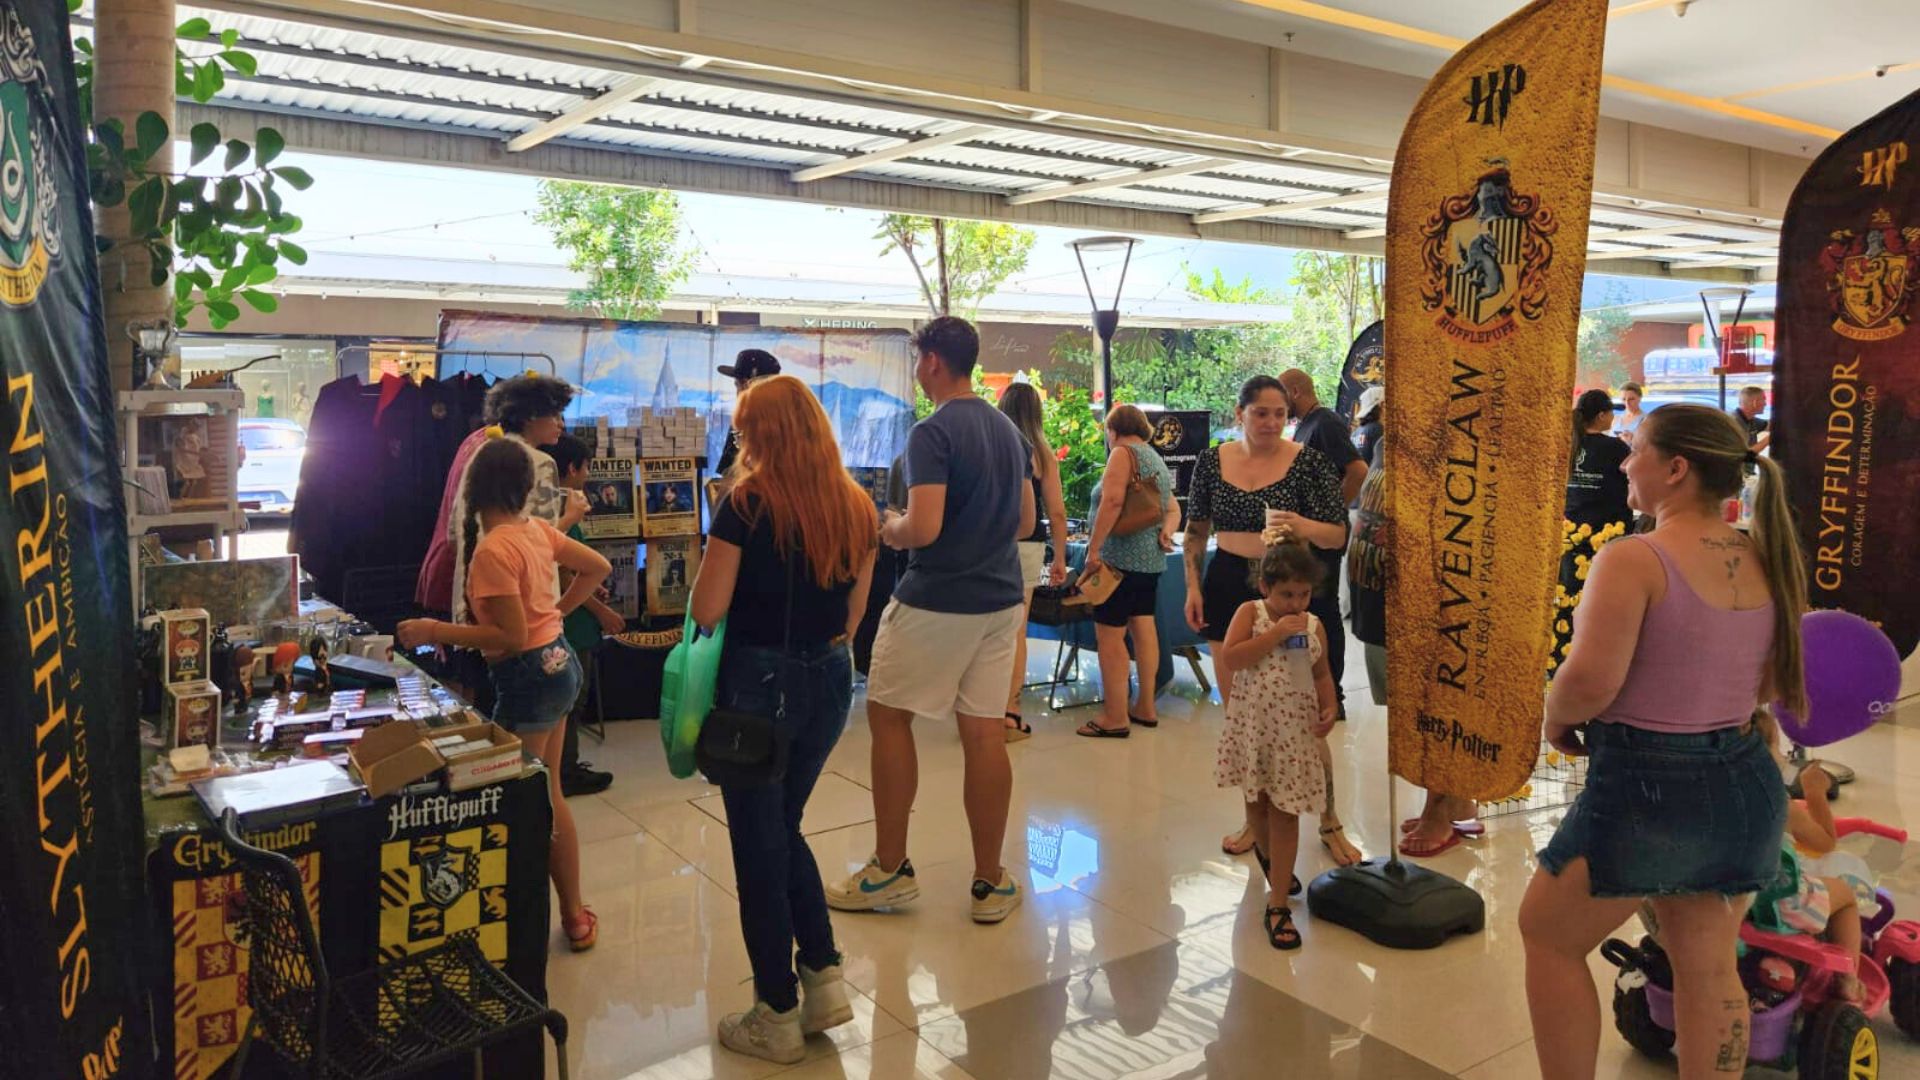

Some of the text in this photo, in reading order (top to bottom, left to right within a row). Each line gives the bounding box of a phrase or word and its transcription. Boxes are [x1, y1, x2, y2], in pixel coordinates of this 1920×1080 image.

[820, 319, 878, 329] HERING
[1438, 318, 1516, 343] HUFFLEPUFF
[588, 459, 633, 470] ANTED
[644, 460, 692, 472] WANTED
[1815, 353, 1861, 591] GRYFFINDOR
[1850, 385, 1877, 567] CORAGEM E DETERMINAÇÃO
[1436, 358, 1487, 693] RAVENCLAW
[1480, 481, 1499, 583] PACIENCIA
[55, 493, 77, 648] AMBIÇÃO
[70, 667, 81, 691] E
[1473, 607, 1492, 699] ENTREGA
[8, 372, 91, 1020] SLYTHERIN
[1451, 719, 1503, 762] Potter
[387, 786, 504, 840] Hufflepuff
